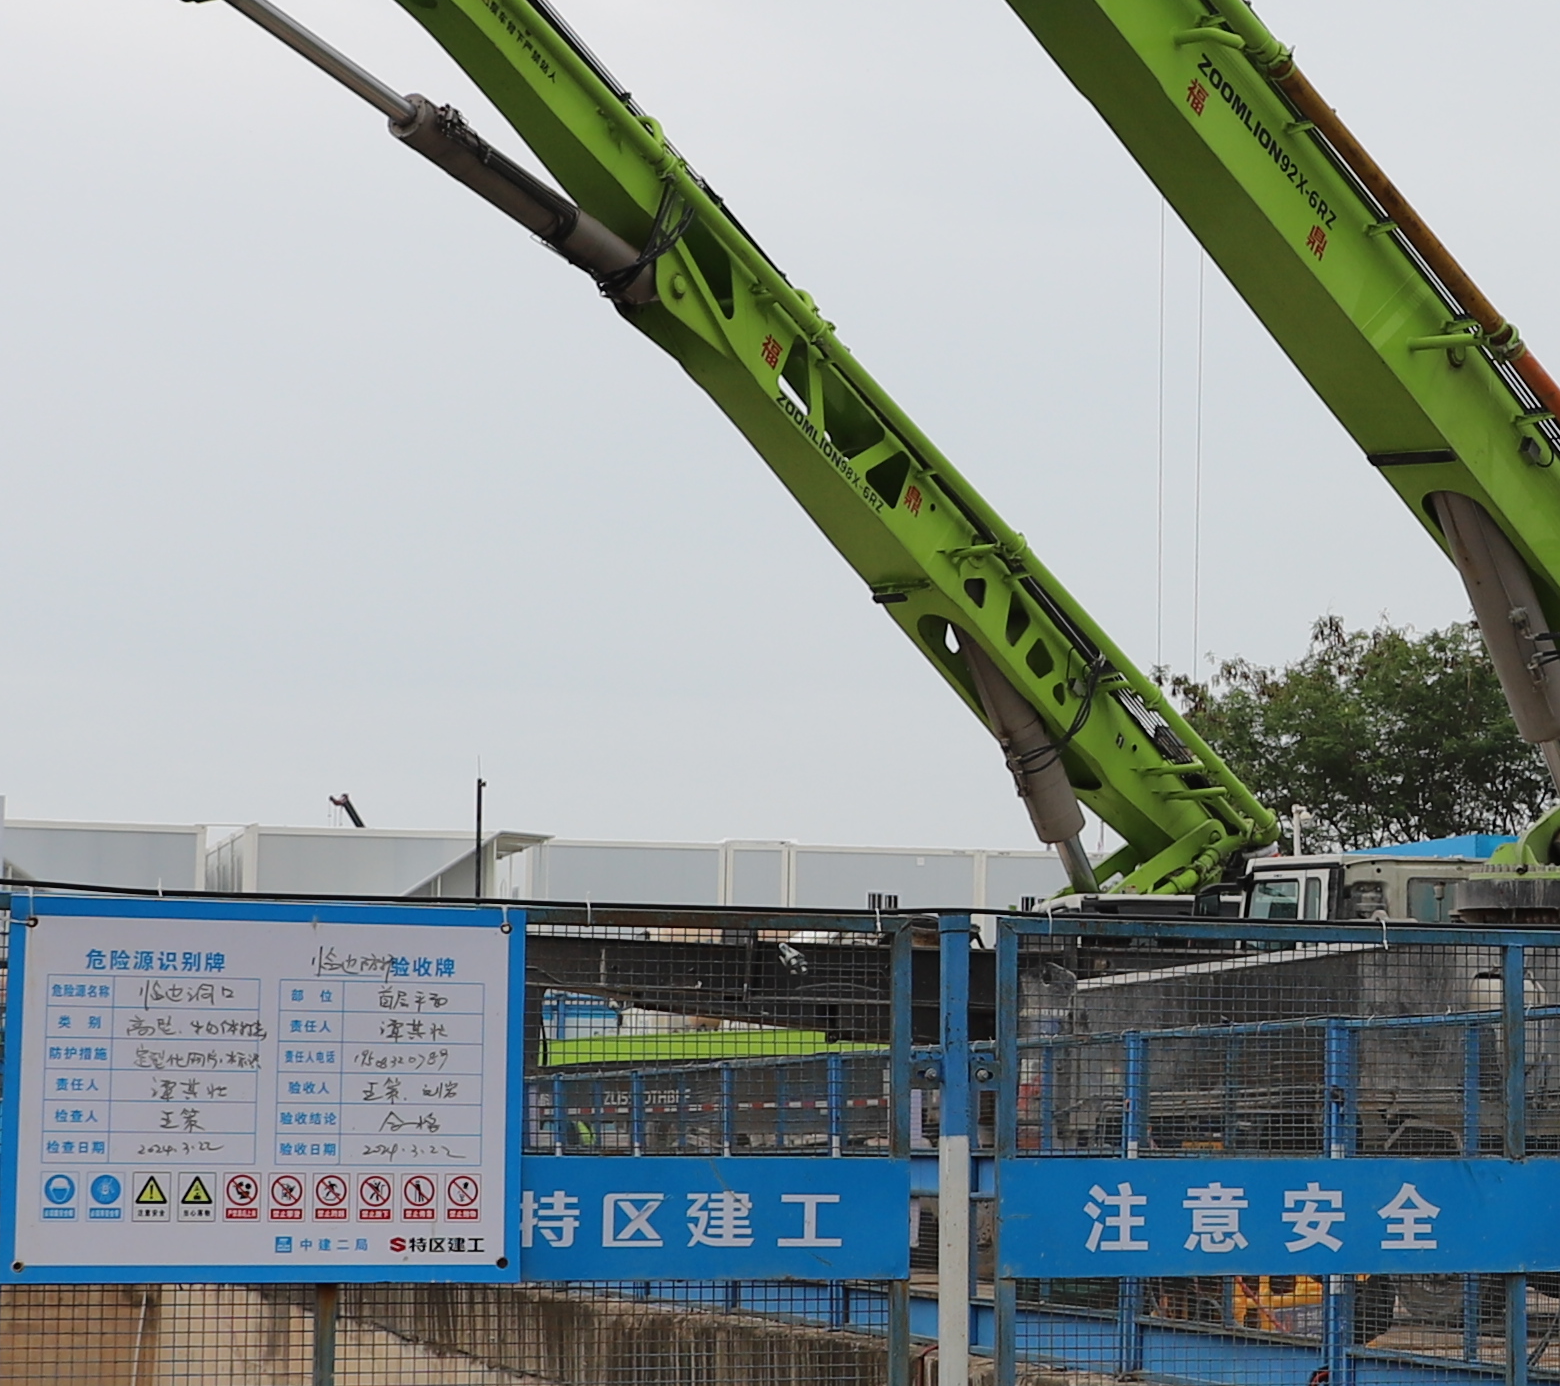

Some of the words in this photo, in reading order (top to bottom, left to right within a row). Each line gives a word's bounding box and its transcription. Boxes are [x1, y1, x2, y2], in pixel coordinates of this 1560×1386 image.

[1186, 78, 1209, 117] 福
[761, 334, 783, 370] 福
[85, 949, 226, 973] 危险源识别牌
[390, 956, 455, 978] 验收牌
[51, 984, 110, 998] 危险源名称
[58, 1016, 101, 1028] 类别
[290, 1020, 331, 1034] 责任人
[49, 1046, 108, 1061] 防护措施
[285, 1050, 335, 1064] 责任人电话
[55, 1078, 99, 1092] 责任人
[288, 1081, 330, 1095] 验收人
[54, 1109, 98, 1123] 检查人
[280, 1112, 337, 1126] 验收结论
[46, 1140, 105, 1155] 检查日期
[279, 1143, 336, 1156] 验收日期
[520, 1190, 842, 1248] 特区建工
[1083, 1182, 1441, 1254] 注意安全
[300, 1237, 368, 1252] 中建二局
[409, 1237, 485, 1252] 特区建工
